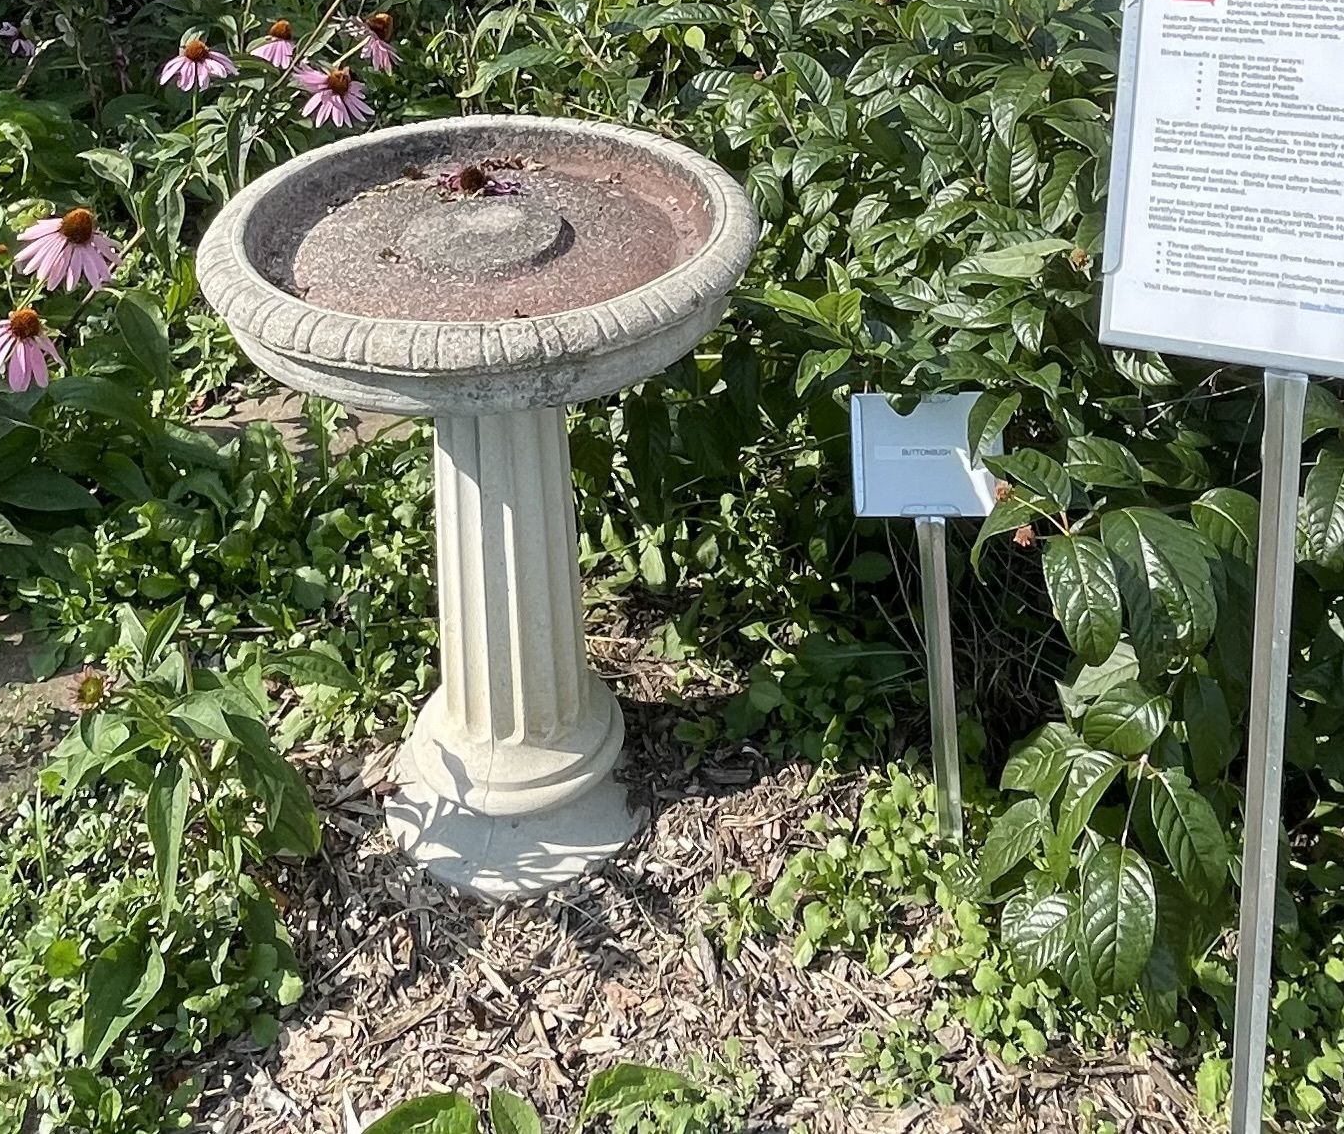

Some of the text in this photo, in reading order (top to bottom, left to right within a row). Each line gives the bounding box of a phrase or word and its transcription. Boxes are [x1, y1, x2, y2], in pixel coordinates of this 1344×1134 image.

[1226, 0, 1252, 8] Bright
[1162, 13, 1187, 21] Native
[1269, 20, 1290, 28] trees
[1291, 21, 1311, 29] have
[1313, 23, 1344, 31] colorful
[1260, 10, 1285, 18] which
[1315, 13, 1334, 21] from
[1161, 32, 1203, 41] strengthen
[1162, 23, 1196, 32] naturally
[1238, 27, 1259, 35] birds
[1260, 28, 1276, 36] that
[1278, 29, 1293, 37] live
[1160, 48, 1181, 56] Birds
[1182, 50, 1210, 58] benefit
[1217, 53, 1246, 61] garden
[1256, 56, 1279, 65] many
[1218, 61, 1296, 73] Birds Spread Seeds
[1217, 69, 1303, 82] Birds Pollinate Plants
[1217, 78, 1294, 91] Birds Control Pests
[1216, 87, 1299, 100] Birds Reduce Weeds
[1264, 100, 1278, 108] Are
[1215, 105, 1236, 113] Birds
[1271, 109, 1331, 121] Environmental
[1155, 118, 1170, 126] The
[1171, 120, 1199, 128] garden
[1200, 121, 1228, 132] display
[1239, 125, 1275, 136] primarily
[1153, 145, 1177, 153] pulled
[1195, 149, 1230, 157] removed
[1252, 153, 1265, 161] the
[1267, 154, 1297, 164] flowers
[1298, 157, 1319, 166] have
[1150, 179, 1177, 190] Beauty
[1179, 182, 1200, 193] Berry
[1147, 221, 1176, 231] Wildlife
[1177, 225, 1206, 235] Habitat
[1165, 249, 1258, 267] One clean water source
[1167, 240, 1189, 250] Three
[1190, 243, 1224, 254] different
[1224, 247, 1244, 256] food
[1245, 251, 1278, 260] sources
[1303, 256, 1334, 266] feeders
[1165, 258, 1181, 267] Two
[1183, 260, 1216, 271] different
[1246, 269, 1279, 278] sources
[1162, 284, 1180, 292] their
[1213, 290, 1225, 298] for
[901, 448, 952, 457] BUTTONBUSH
